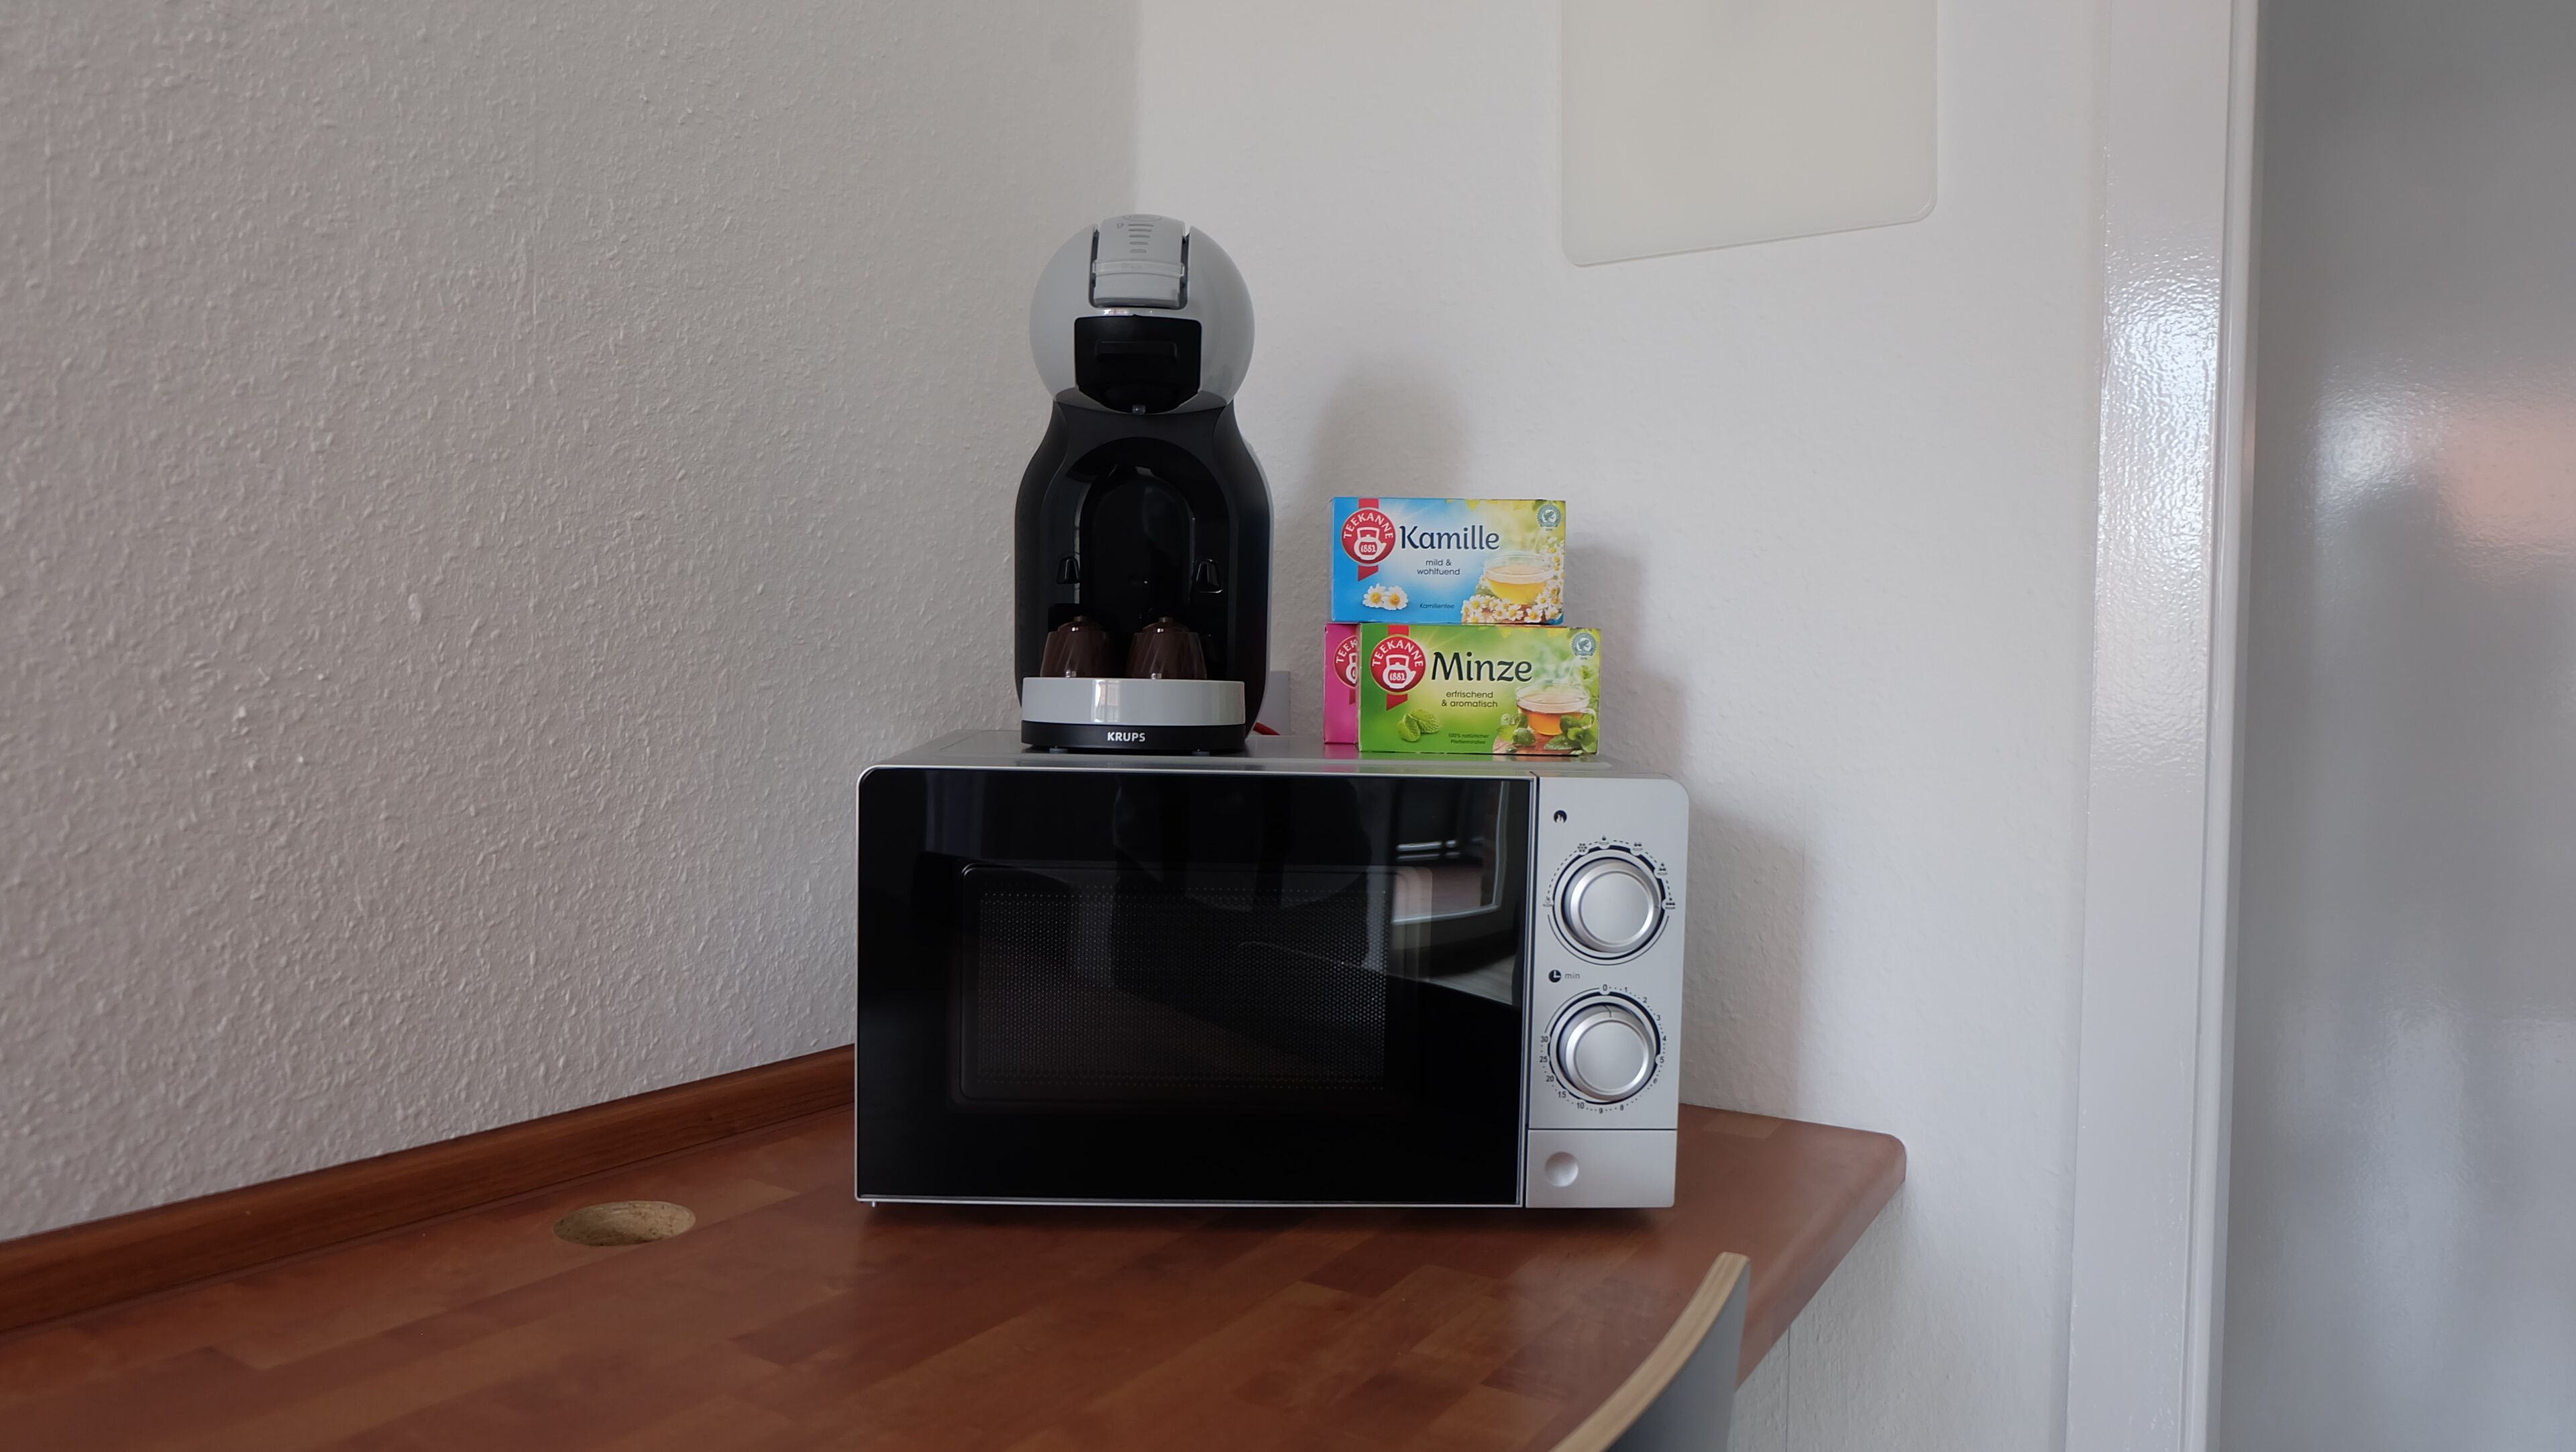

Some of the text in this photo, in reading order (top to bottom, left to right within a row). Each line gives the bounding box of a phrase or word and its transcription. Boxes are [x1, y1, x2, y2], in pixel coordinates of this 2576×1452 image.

[1343, 512, 1394, 539] TEEKANNE
[1399, 525, 1500, 550] Kamille
[1446, 558, 1452, 566] &
[1336, 639, 1358, 664] TEEK
[1372, 639, 1424, 668] TEEKANNE
[1431, 651, 1532, 682] Minze
[1446, 690, 1494, 698] erfrischend
[1442, 698, 1498, 708] & aromatisch
[1107, 731, 1146, 741] KRUPS
[1602, 984, 1608, 992] 0
